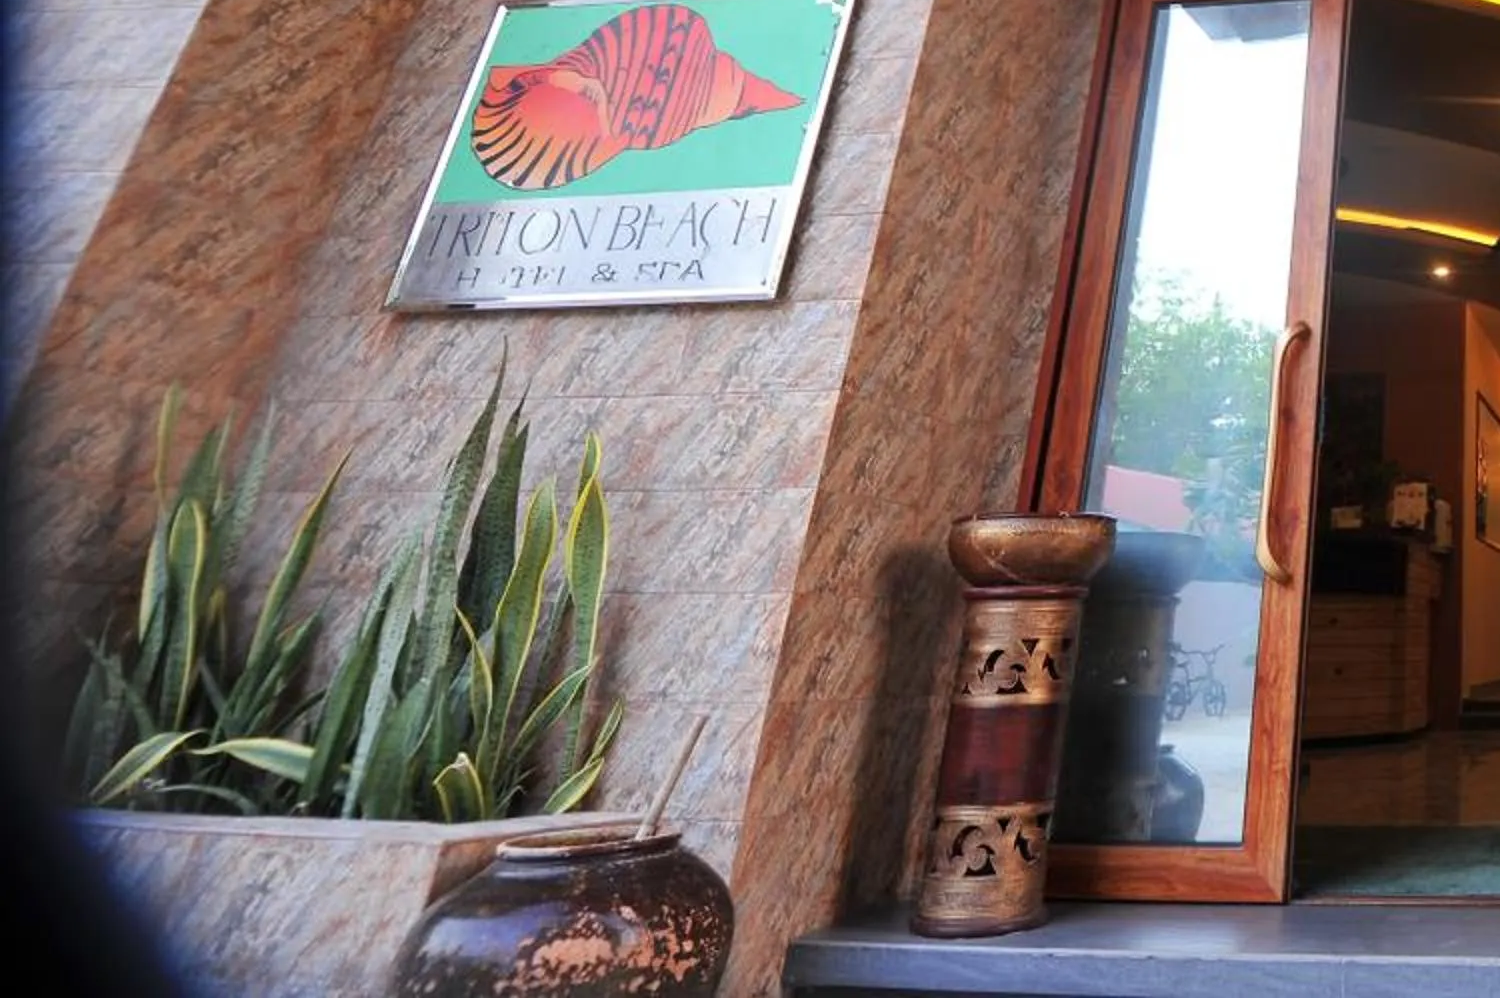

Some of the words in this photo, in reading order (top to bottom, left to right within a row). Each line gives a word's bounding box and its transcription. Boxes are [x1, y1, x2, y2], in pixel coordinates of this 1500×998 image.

[428, 206, 601, 258] TRITON
[606, 197, 778, 252] BEACH
[456, 265, 566, 290] HTEL
[590, 262, 617, 284] &
